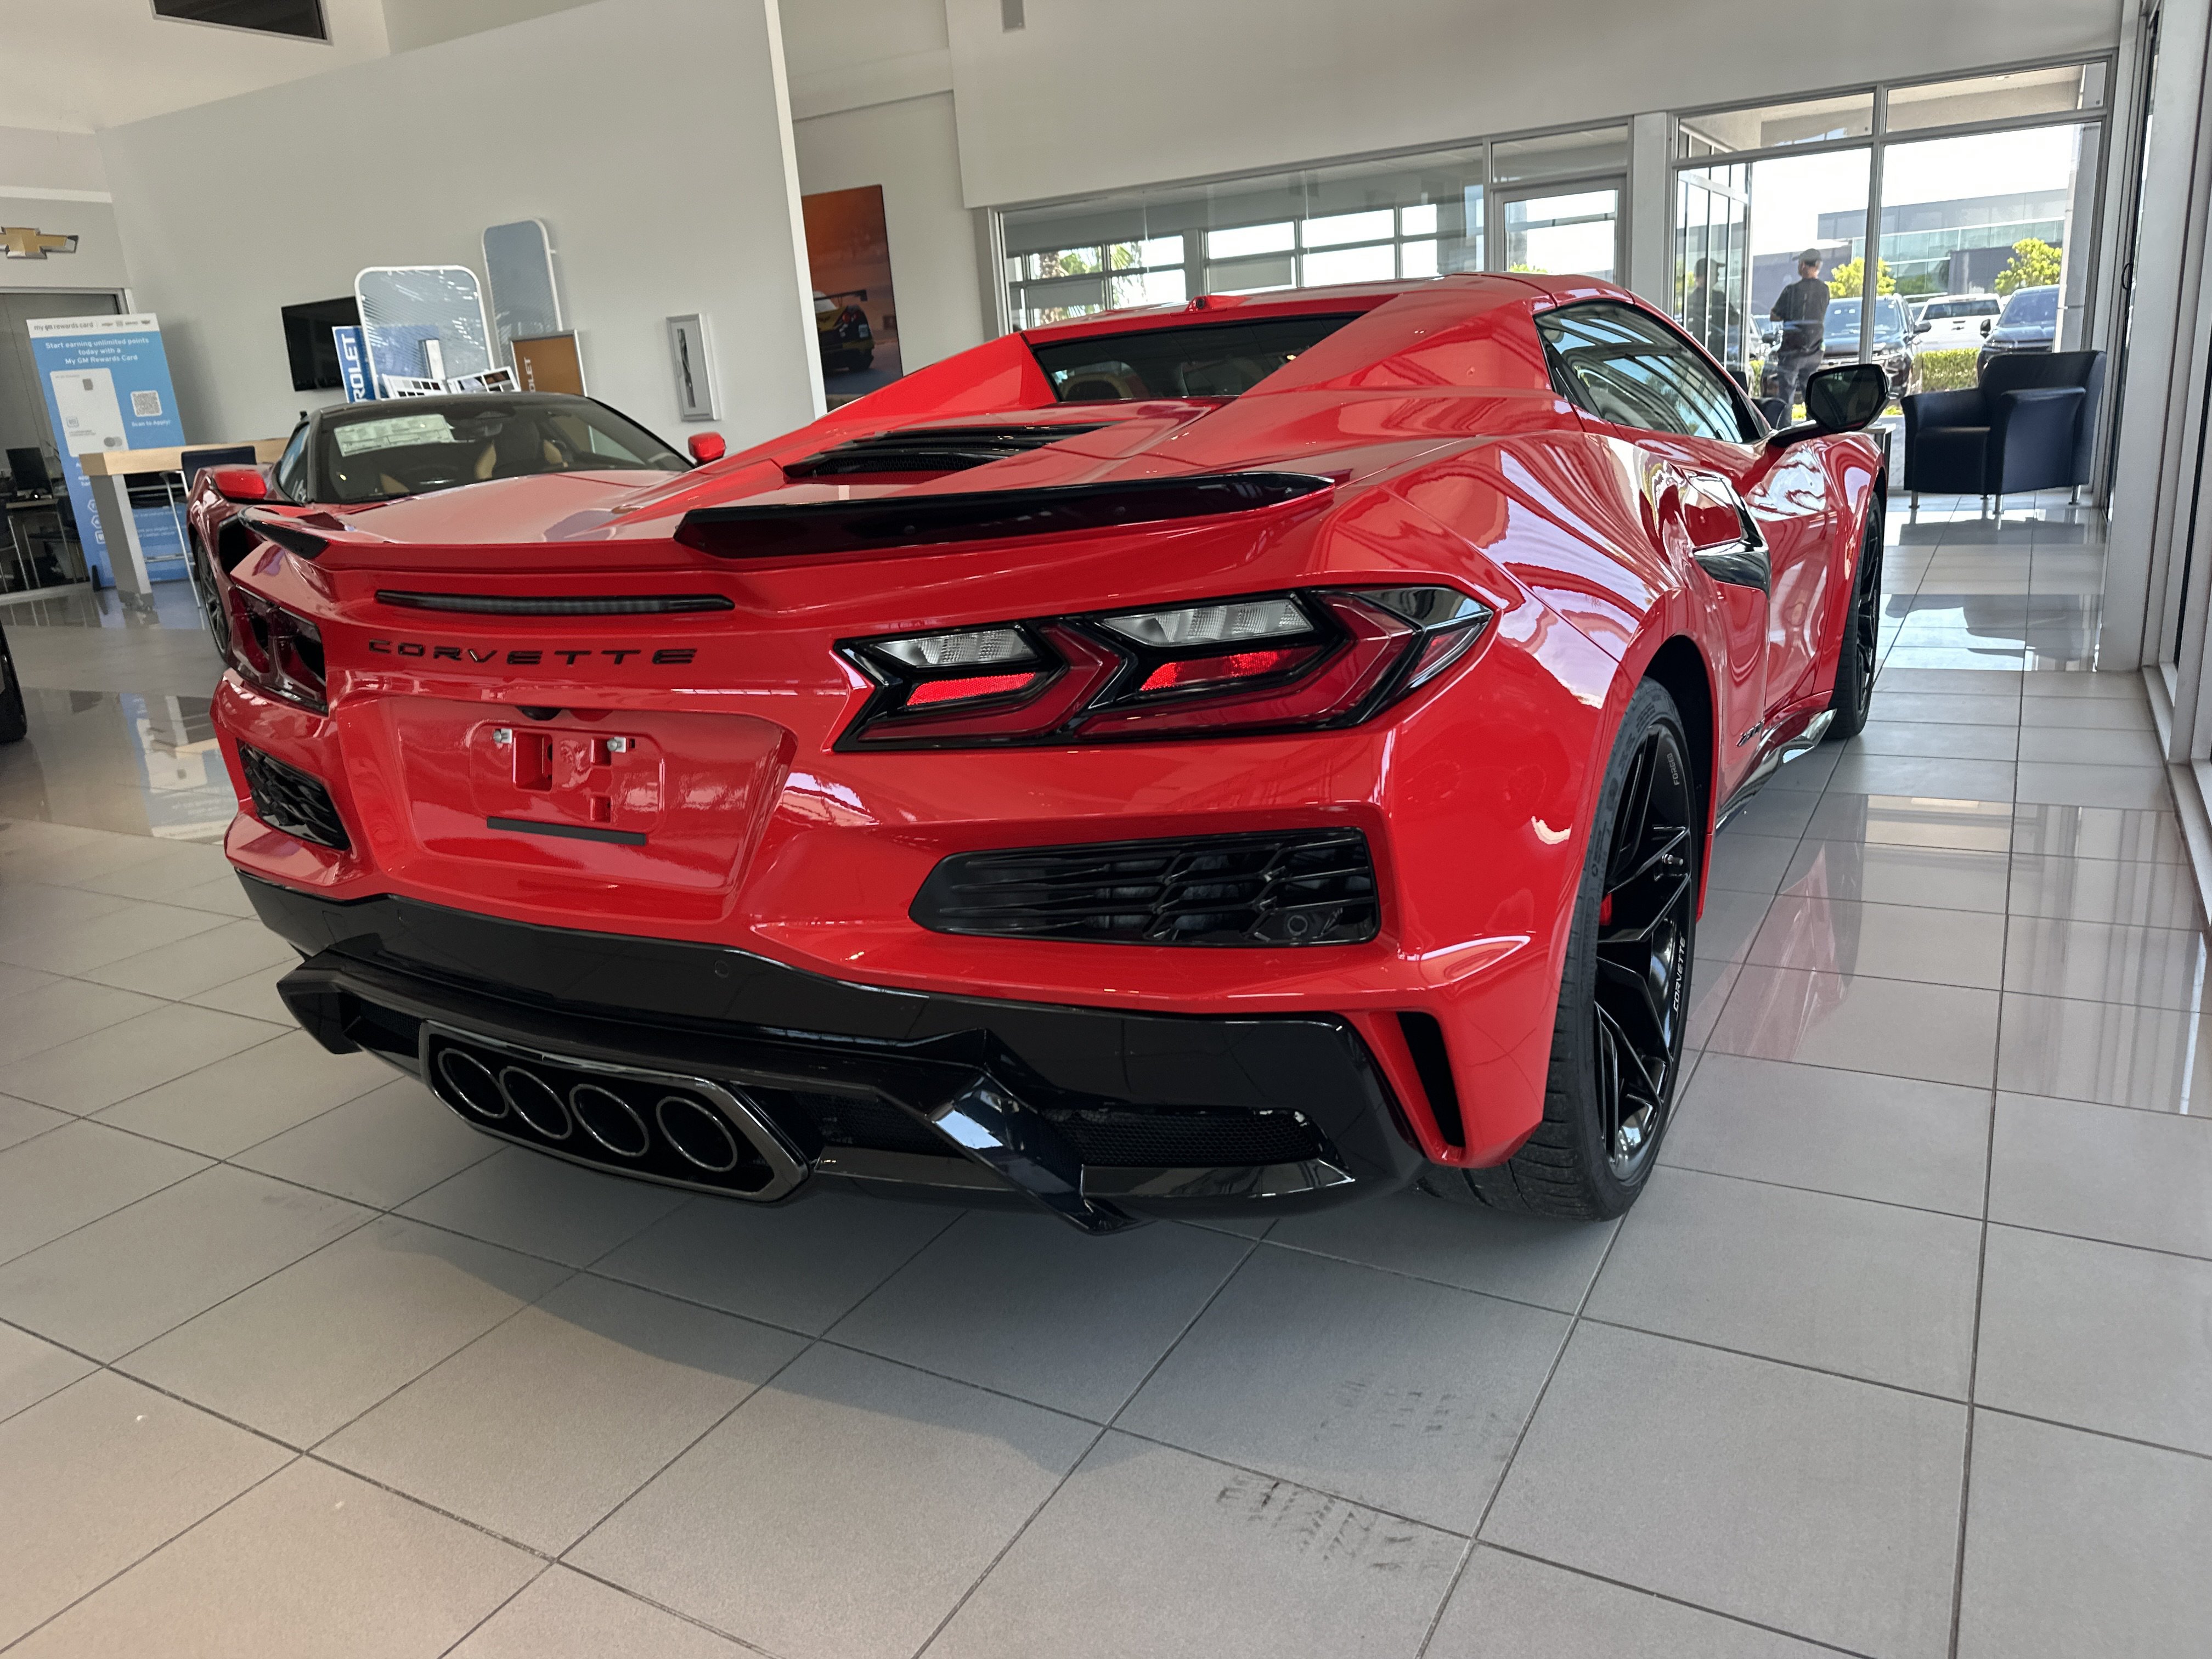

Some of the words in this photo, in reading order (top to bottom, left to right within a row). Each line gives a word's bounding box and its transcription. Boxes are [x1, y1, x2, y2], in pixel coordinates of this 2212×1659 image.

[369, 639, 697, 665] CORVETTE
[1667, 753, 1680, 785] FORGED
[1673, 936, 1686, 1012] CORVETTE
